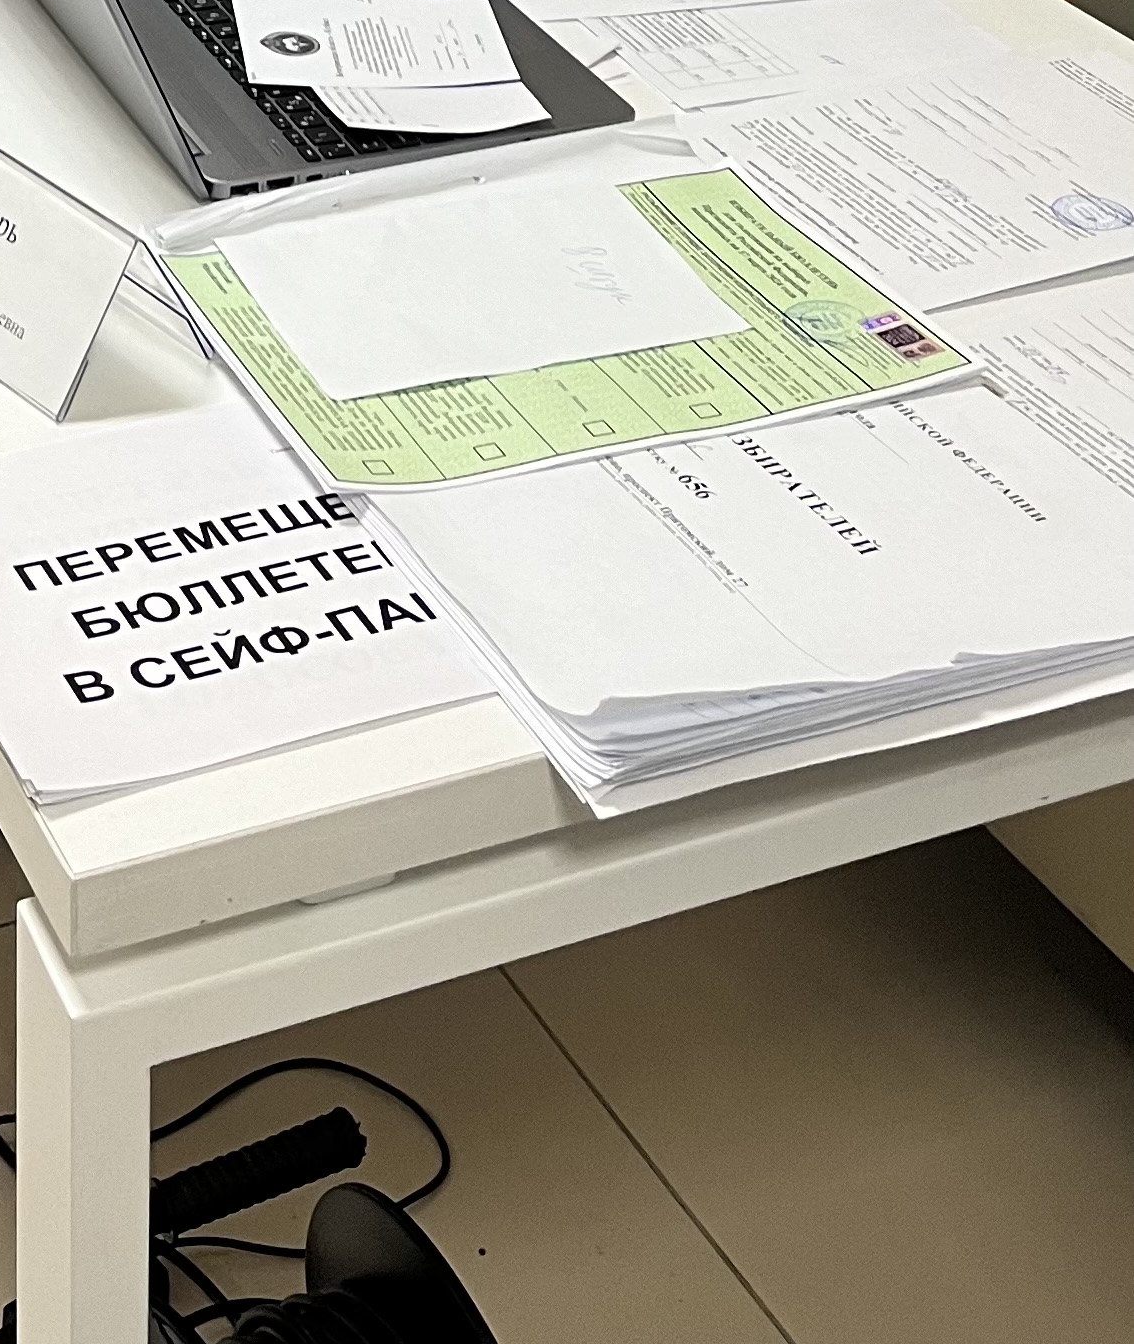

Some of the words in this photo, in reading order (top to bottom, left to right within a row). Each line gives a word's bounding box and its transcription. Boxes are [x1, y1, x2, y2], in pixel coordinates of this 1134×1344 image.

[677, 473, 718, 500] 656
[729, 434, 883, 556] ЗБИРАТЕЛЕЙ
[953, 447, 1047, 523] ФЕДЕРАЦИИ
[13, 491, 356, 593] ПЕРЕМЕЩЕ
[63, 670, 116, 704] В
